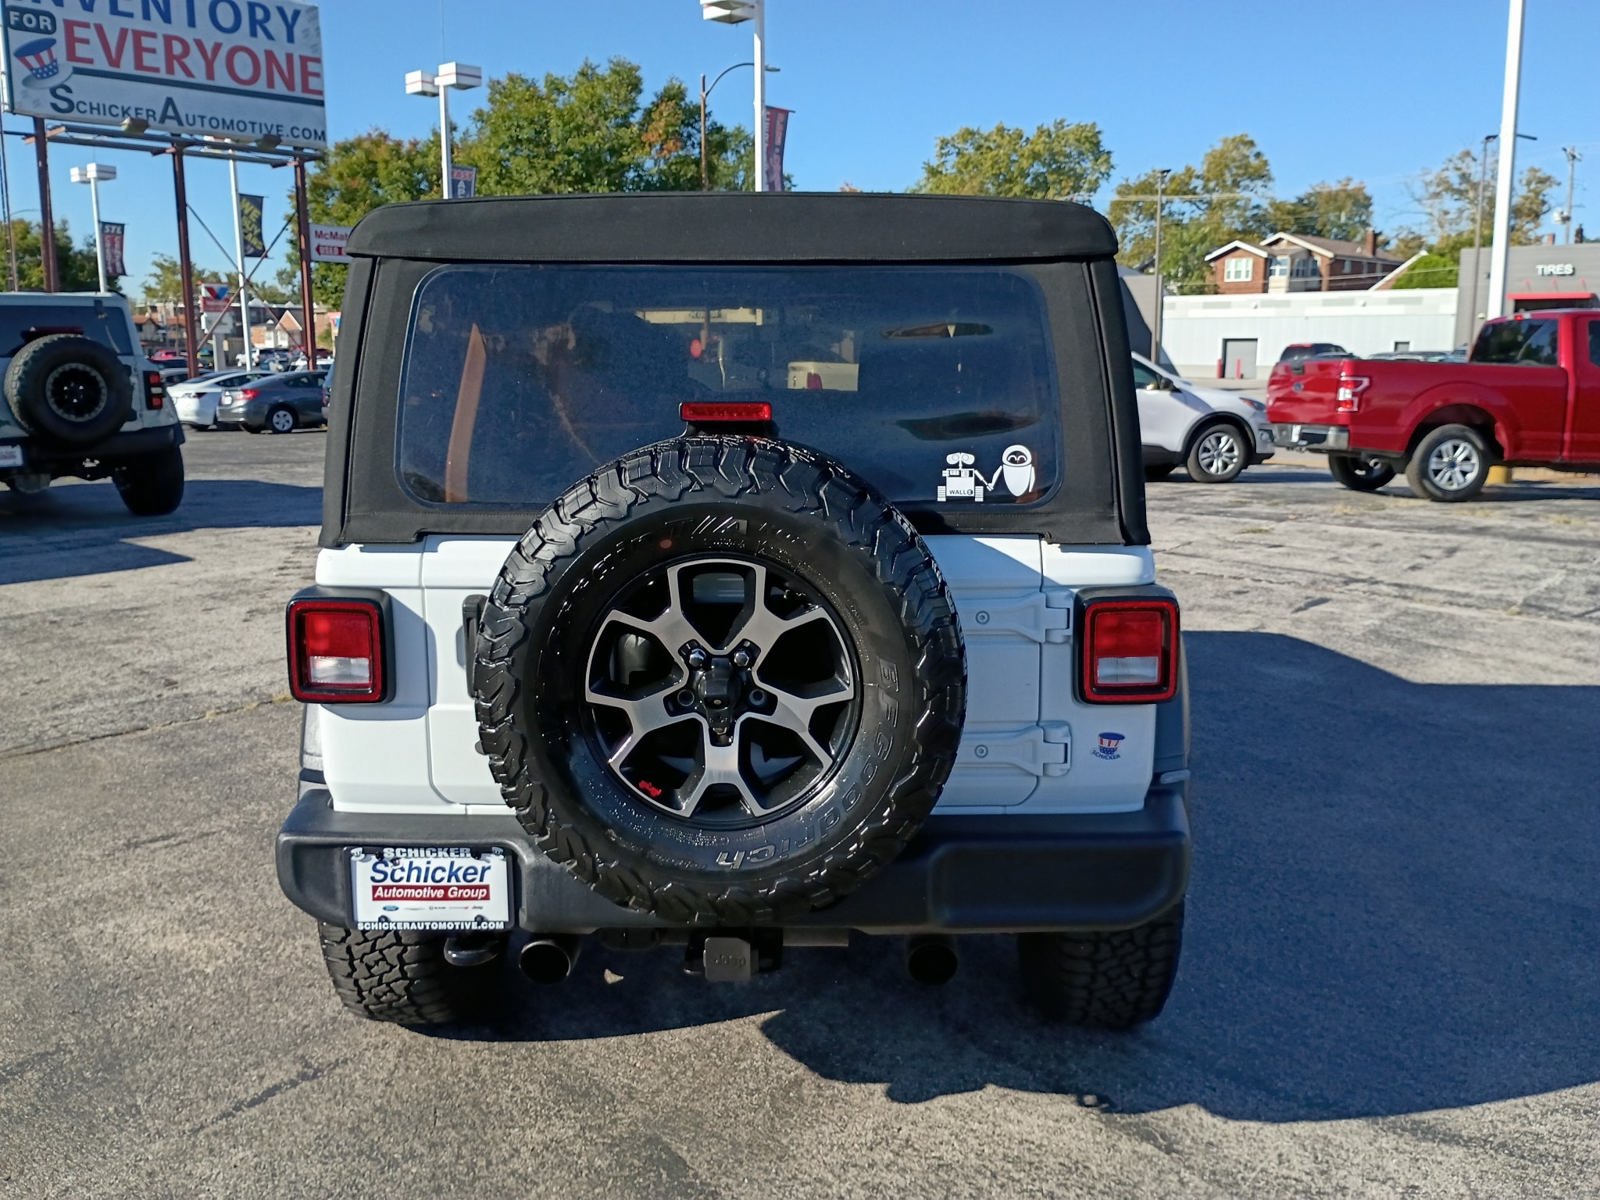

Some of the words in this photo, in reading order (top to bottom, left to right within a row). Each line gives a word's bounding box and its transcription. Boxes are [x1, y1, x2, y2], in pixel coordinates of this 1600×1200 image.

[9, 11, 52, 30] FOR
[15, 0, 301, 43] ENTORY
[63, 19, 324, 96] EVERYONE
[1536, 263, 1575, 276] TIRES
[383, 847, 471, 859] SCHICKER
[370, 860, 491, 883] Schicker
[374, 886, 445, 898] Automotive
[447, 887, 487, 900] Group
[357, 921, 504, 931] SCHICKERAUTOMOTIVE.COM
